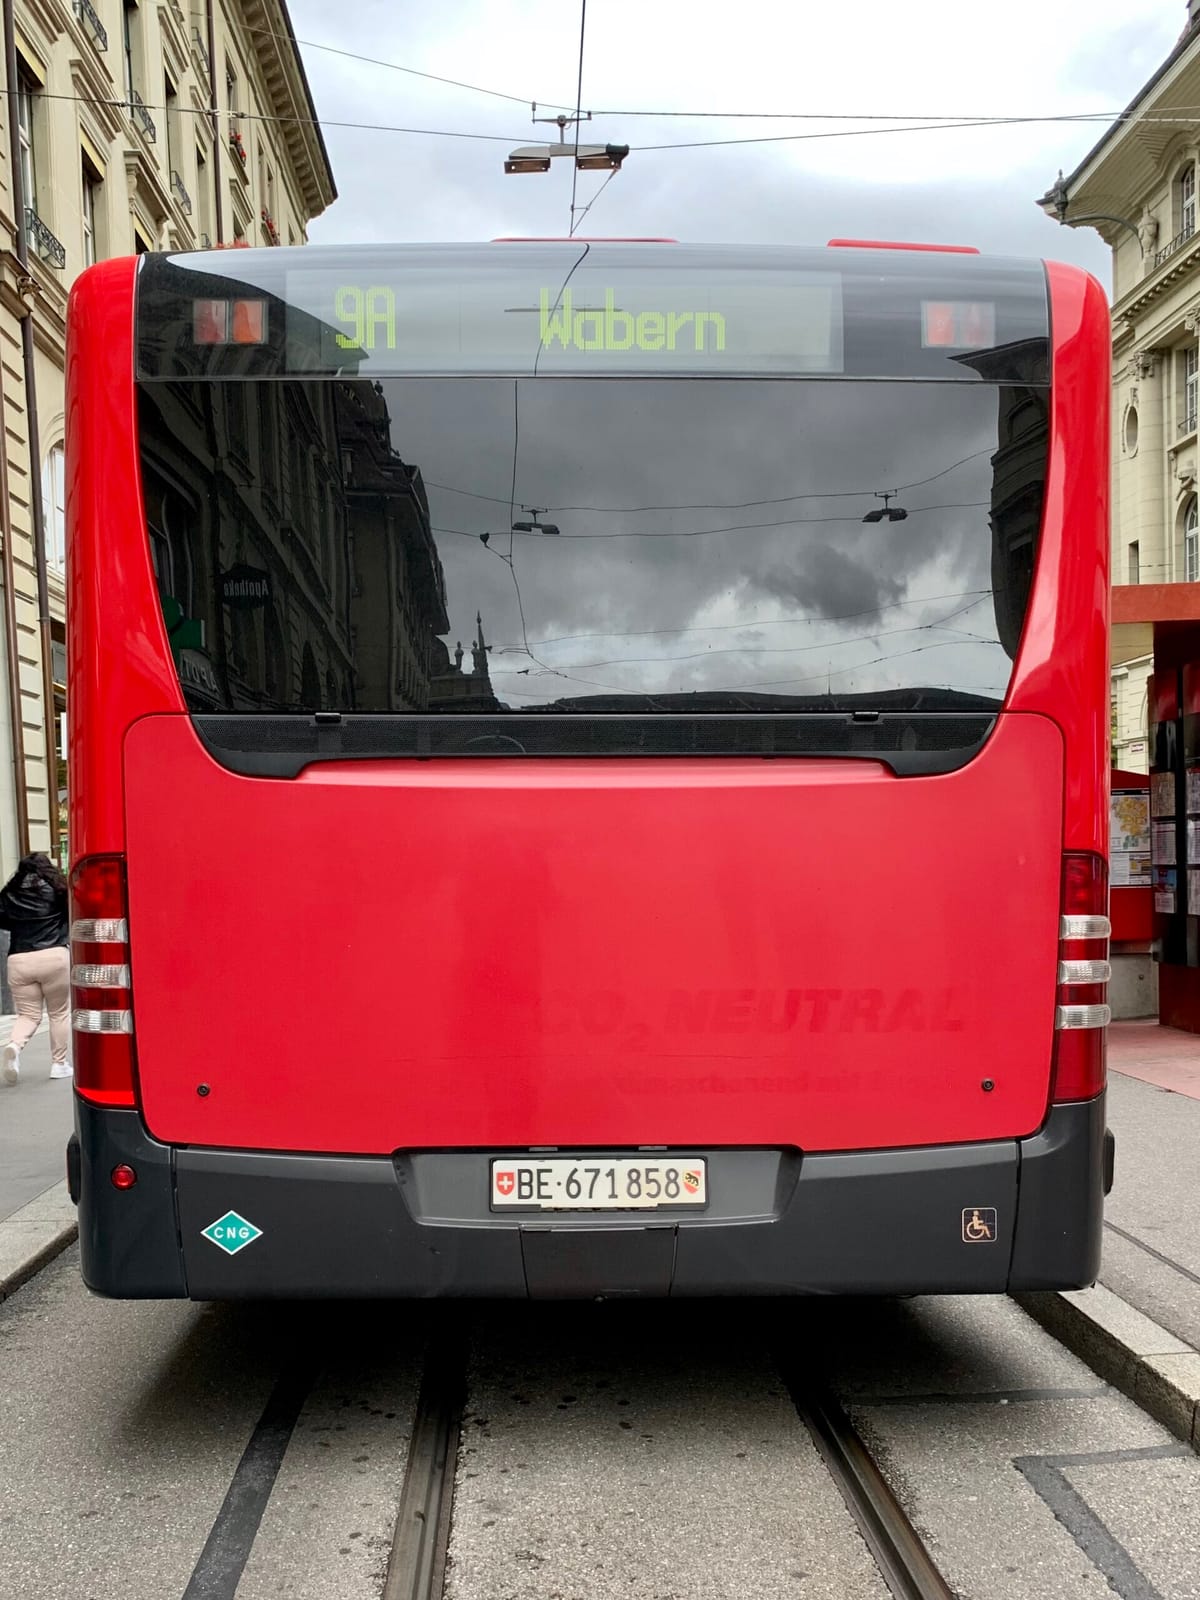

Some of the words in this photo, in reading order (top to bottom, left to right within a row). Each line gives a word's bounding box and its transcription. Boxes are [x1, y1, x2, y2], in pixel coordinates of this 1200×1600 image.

[335, 286, 396, 349] 9A
[539, 287, 726, 351] Wabern
[663, 988, 966, 1034] NEUTRAL
[213, 1226, 250, 1239] CNG
